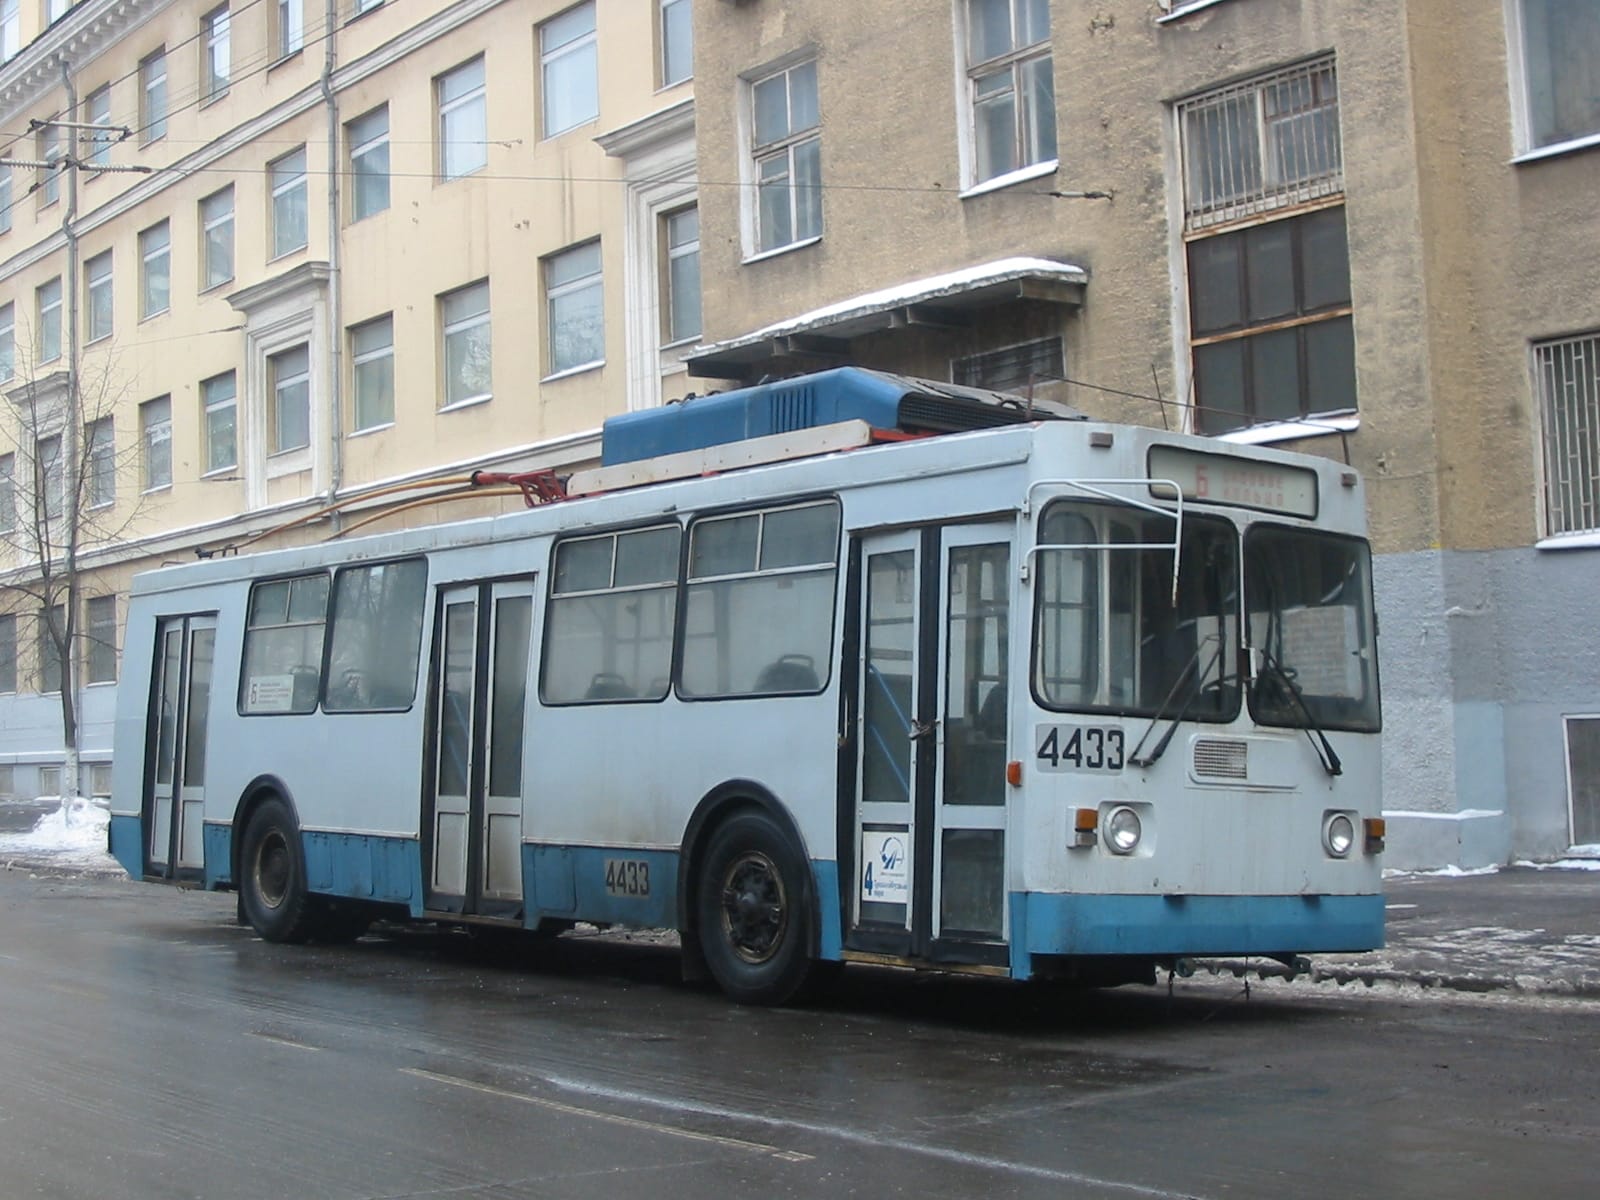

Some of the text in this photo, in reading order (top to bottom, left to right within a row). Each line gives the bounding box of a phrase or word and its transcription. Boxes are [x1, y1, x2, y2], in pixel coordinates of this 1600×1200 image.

[1037, 727, 1124, 770] 4433
[606, 860, 649, 896] 4433
[864, 861, 873, 896] 4
